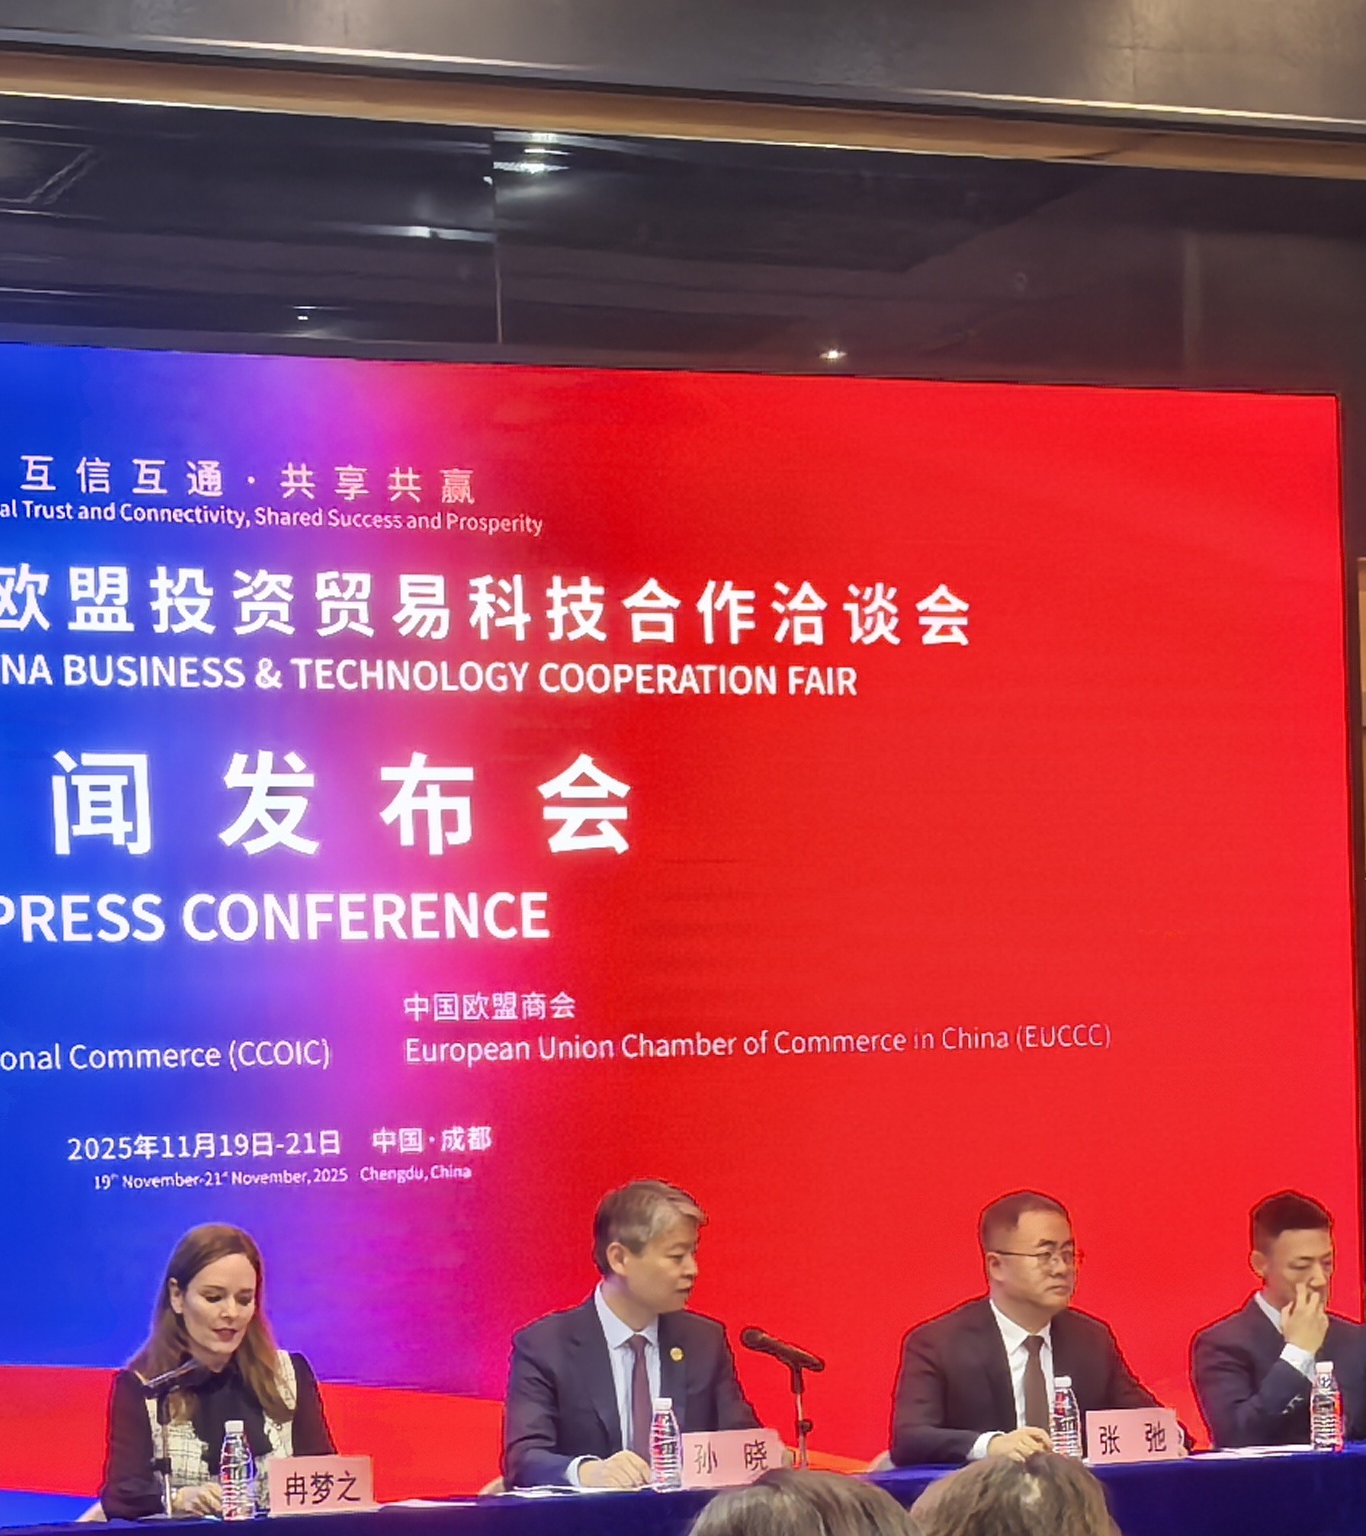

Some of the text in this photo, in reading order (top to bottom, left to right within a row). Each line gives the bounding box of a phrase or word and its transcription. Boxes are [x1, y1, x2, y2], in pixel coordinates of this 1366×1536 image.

[19, 455, 475, 505] 互信互通·共享共赢
[22, 500, 74, 519] Trust
[77, 502, 115, 521] and
[120, 503, 251, 528] Connectivity,
[255, 507, 323, 526] Shared
[327, 510, 403, 529] Success
[407, 511, 441, 530] and
[446, 513, 543, 536] Prosperity
[64, 653, 246, 689] BUSINESS
[254, 658, 283, 690] &
[290, 657, 528, 693] TECHNOLOGY
[539, 660, 778, 696] COOPERATION
[787, 665, 858, 696] FAIR
[181, 891, 550, 942] CONFERENCE
[403, 991, 576, 1022] 中国欧盟商会
[68, 1043, 221, 1070] Commerce
[228, 1038, 331, 1071] (CCOIC)
[405, 1023, 1112, 1068] European Union Chamber of Commerce in China (EUCCC)
[67, 1125, 492, 1161] 2025年11月19日-21日 中国·成都
[284, 1471, 361, 1506] 冉梦之
